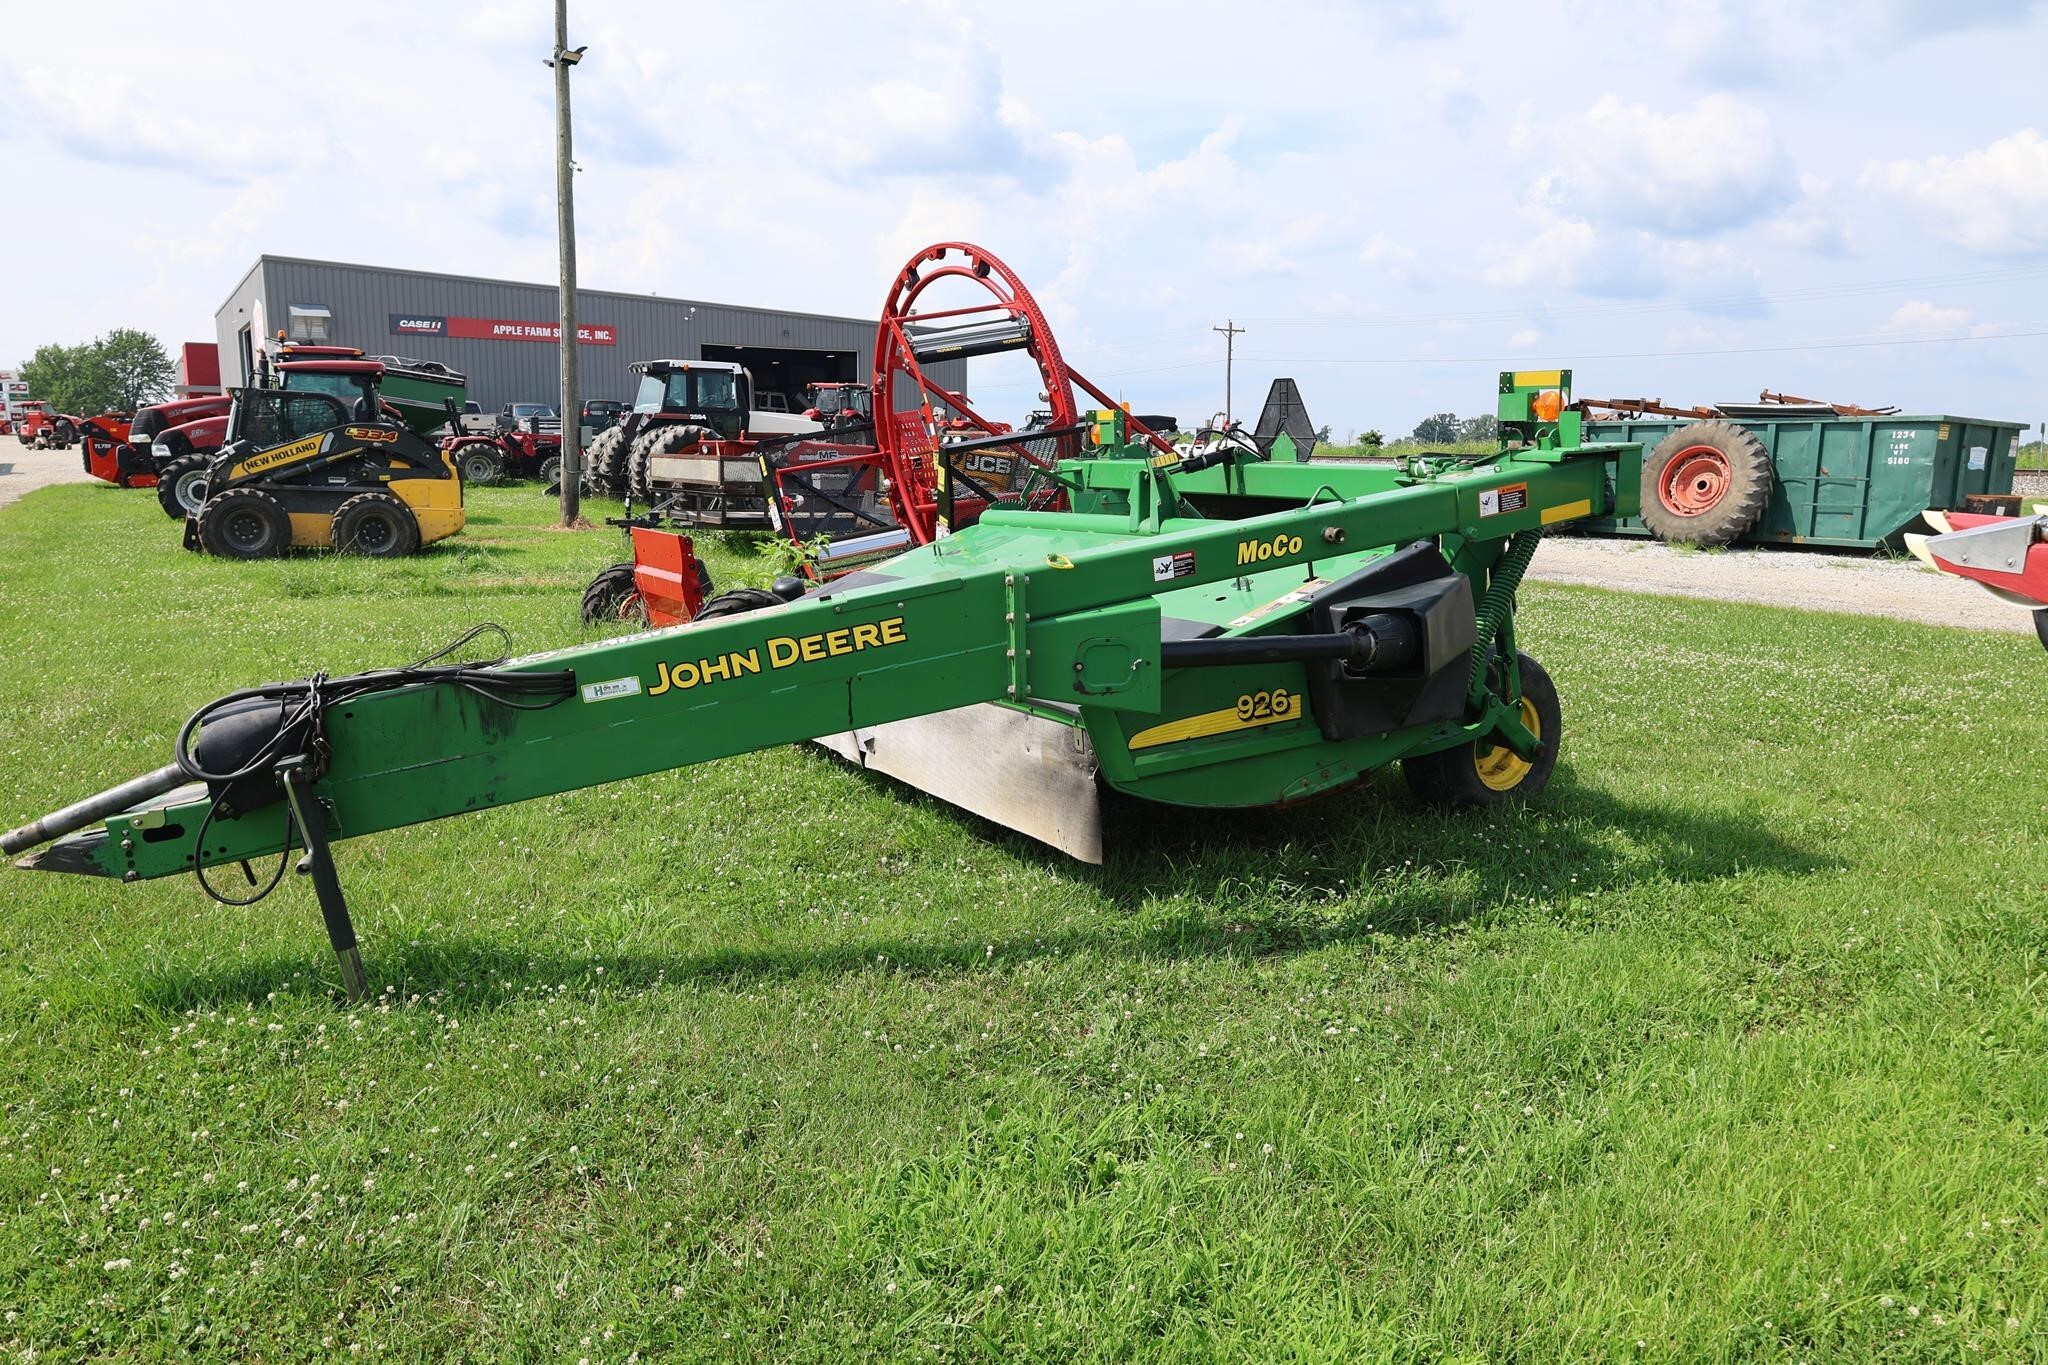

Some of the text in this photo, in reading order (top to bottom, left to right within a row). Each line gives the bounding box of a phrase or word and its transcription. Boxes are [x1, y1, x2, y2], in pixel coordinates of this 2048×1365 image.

[399, 319, 431, 329] CASE
[493, 324, 523, 335] APPLE
[525, 326, 551, 337] FARM
[594, 330, 612, 340] INC.
[1892, 430, 1916, 439] 1234
[245, 456, 270, 470] NEW
[270, 442, 317, 462] HOLLAND
[966, 455, 1012, 474] JCB
[1236, 533, 1304, 566] MoCo
[648, 617, 908, 696] JOHN DEERE
[1237, 687, 1291, 722] 926
